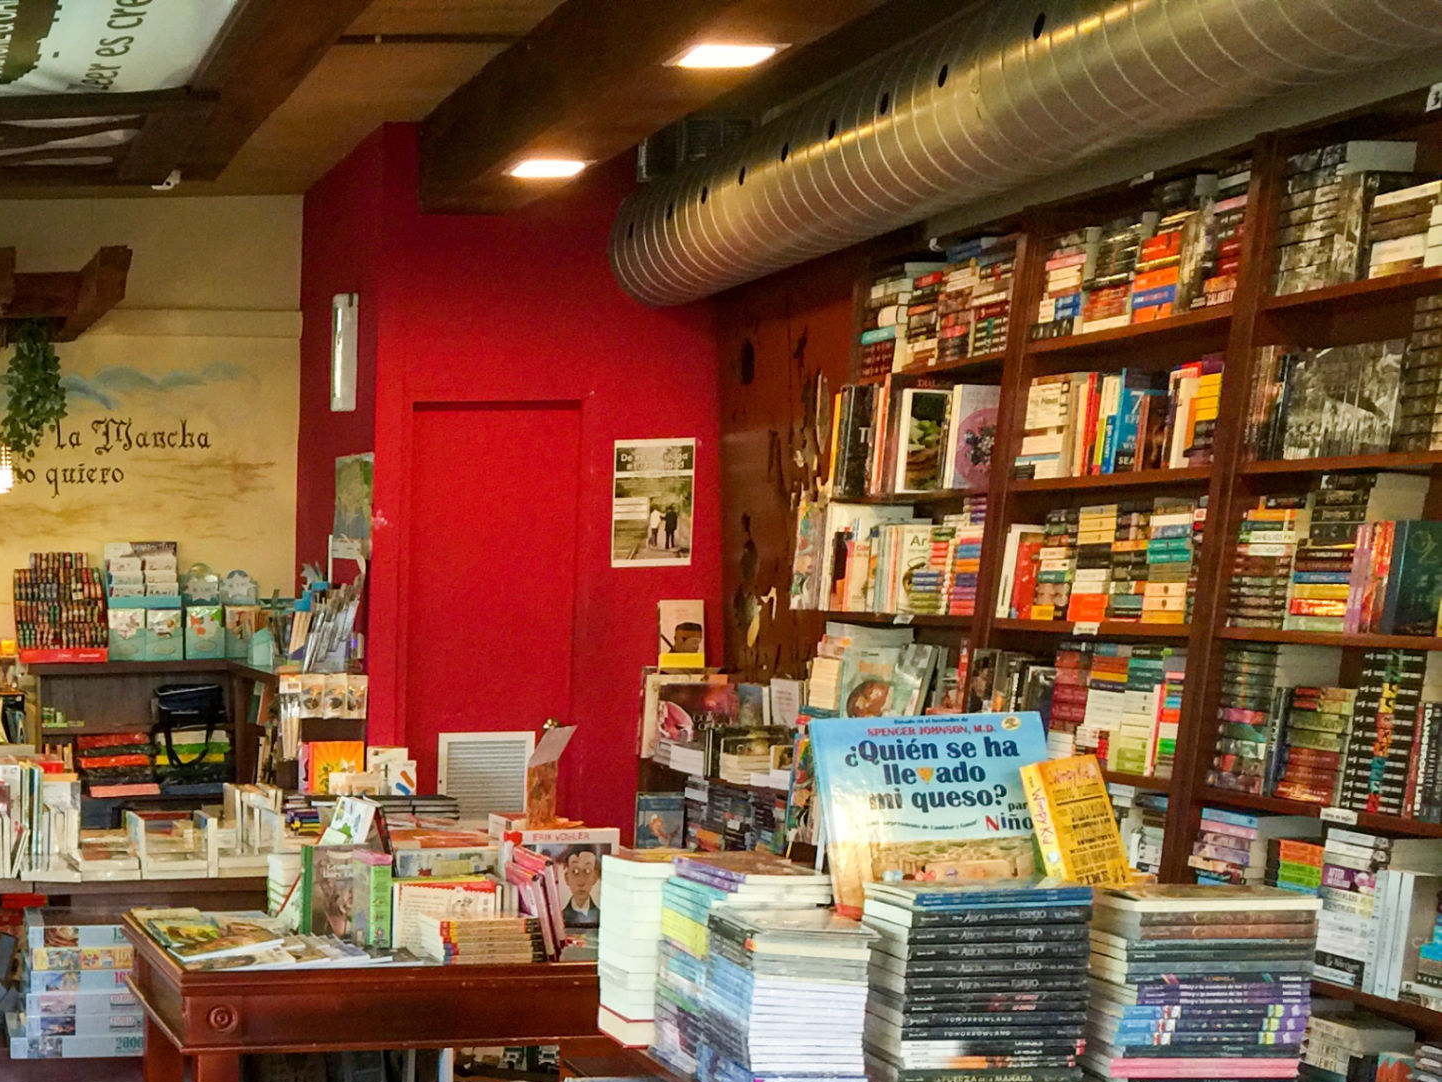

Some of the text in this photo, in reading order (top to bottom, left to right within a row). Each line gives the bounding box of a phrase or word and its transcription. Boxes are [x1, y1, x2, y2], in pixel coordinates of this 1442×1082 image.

[94, 35, 137, 57] es
[55, 420, 83, 450] la
[91, 417, 212, 455] Mancha
[45, 463, 125, 499] quiero
[867, 727, 916, 737] SPENCER
[845, 736, 1020, 767] ¿Quién se ha
[869, 784, 1007, 812] mi queso?
[994, 1074, 1033, 1082] MANADA
